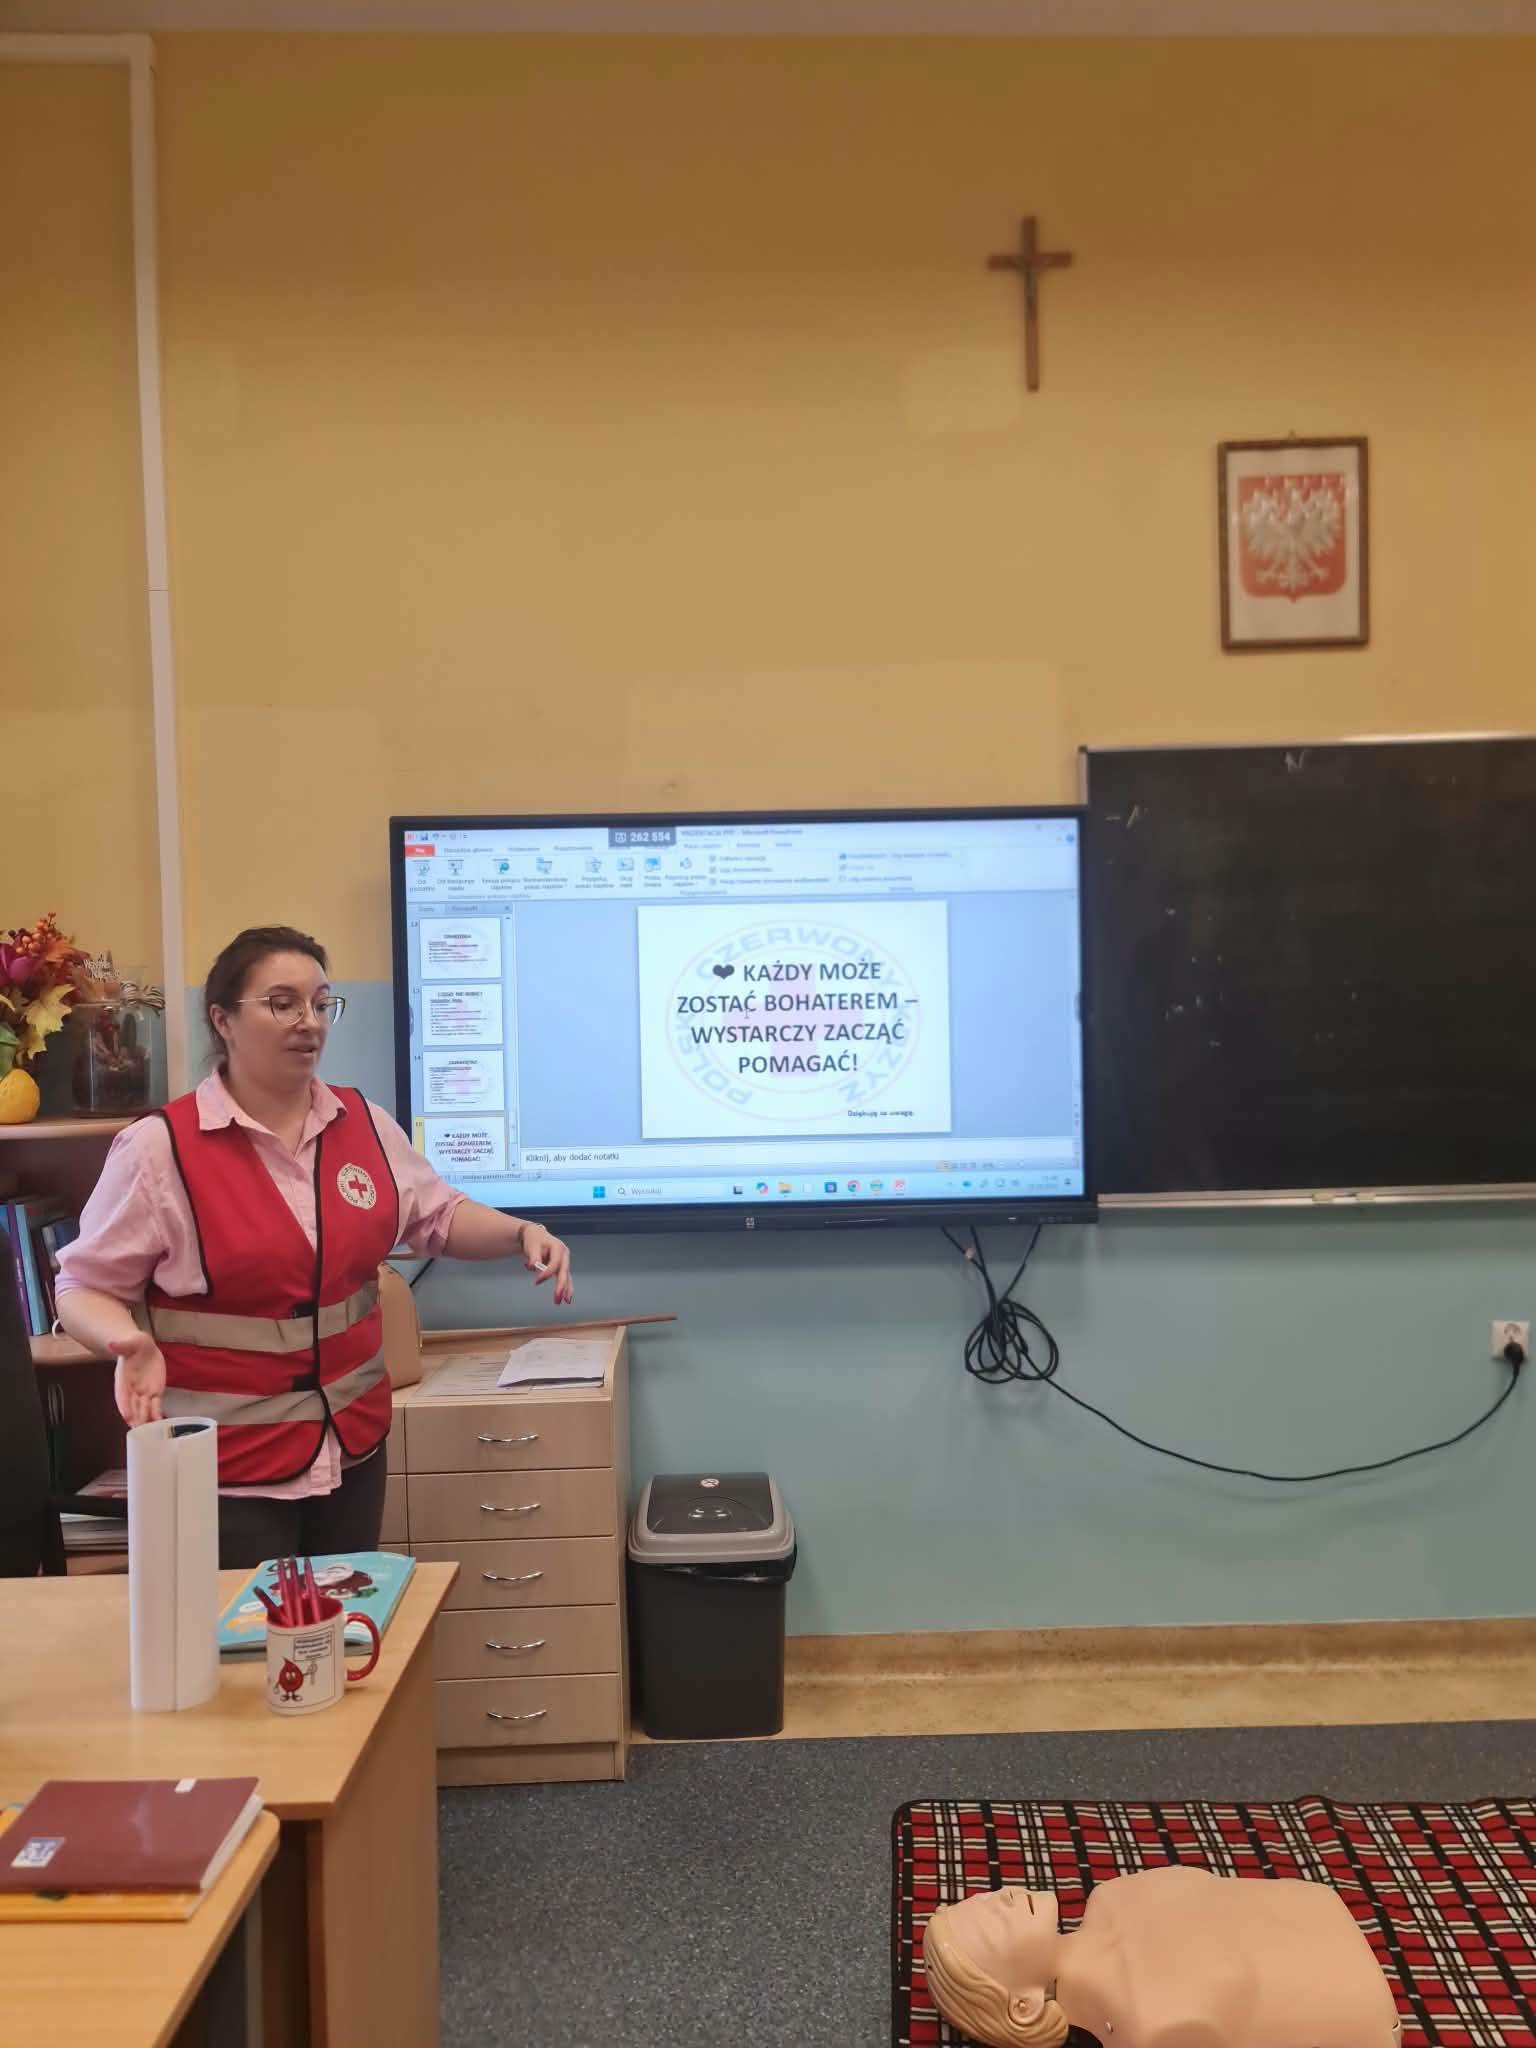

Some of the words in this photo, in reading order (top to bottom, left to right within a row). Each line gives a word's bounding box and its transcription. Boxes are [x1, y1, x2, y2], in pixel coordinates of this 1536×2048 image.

[630, 832, 649, 842] 262
[652, 832, 671, 842] 554
[743, 960, 813, 982] KAŻDY
[819, 957, 882, 982] MOŻE
[677, 990, 758, 1014] ZOSTAĆ
[764, 992, 899, 1012] BOHATEREM
[690, 1024, 817, 1045] WYSTARCZY
[823, 1018, 906, 1045] ZACZĄĆ
[738, 1050, 859, 1074] POMAGAĆ!
[553, 1154, 567, 1163] aby
[569, 1152, 592, 1161] dodać
[594, 1152, 619, 1161] notatki
